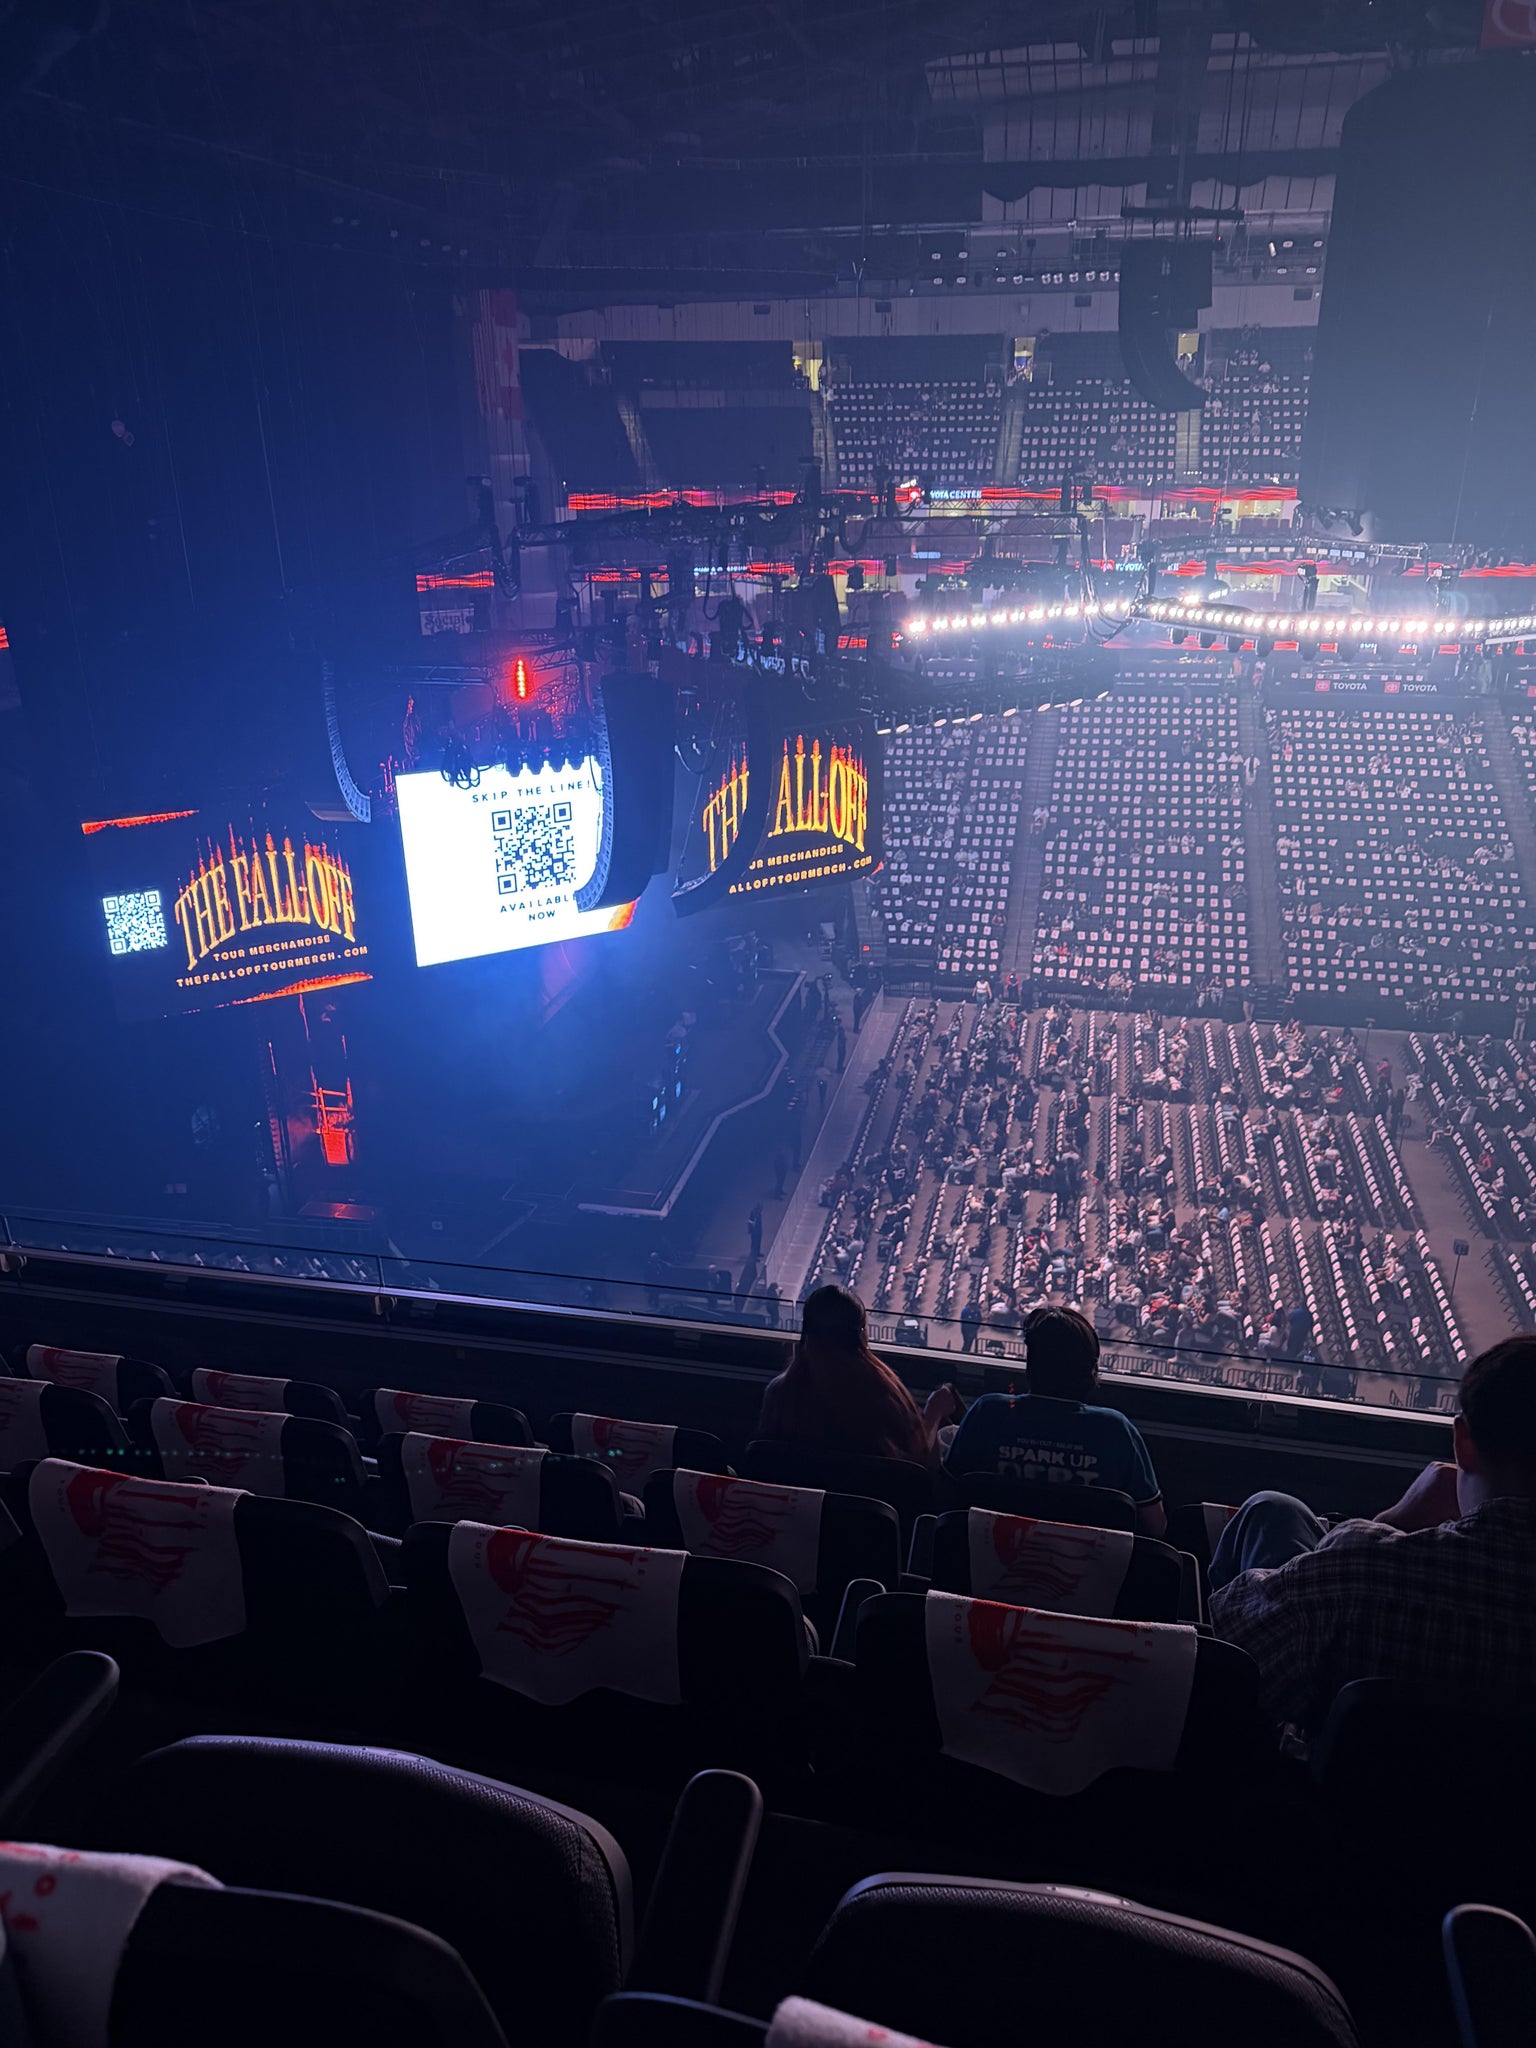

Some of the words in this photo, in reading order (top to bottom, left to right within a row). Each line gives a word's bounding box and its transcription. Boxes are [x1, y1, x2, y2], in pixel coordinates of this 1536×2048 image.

[950, 489, 982, 499] CENTER
[1333, 682, 1368, 691] TOYOTA
[1403, 684, 1438, 692] TOYOTA
[472, 791, 508, 803] SKIP
[517, 786, 542, 797] THE
[550, 780, 591, 793] LINE!
[767, 844, 844, 867] MERCHANDISE
[174, 864, 236, 971] THE
[528, 910, 556, 921] NOW
[213, 949, 246, 962] TOUR
[249, 934, 331, 956] MERCHANDISE
[999, 1446, 1065, 1466] SPARK
[1070, 1454, 1098, 1469] UP
